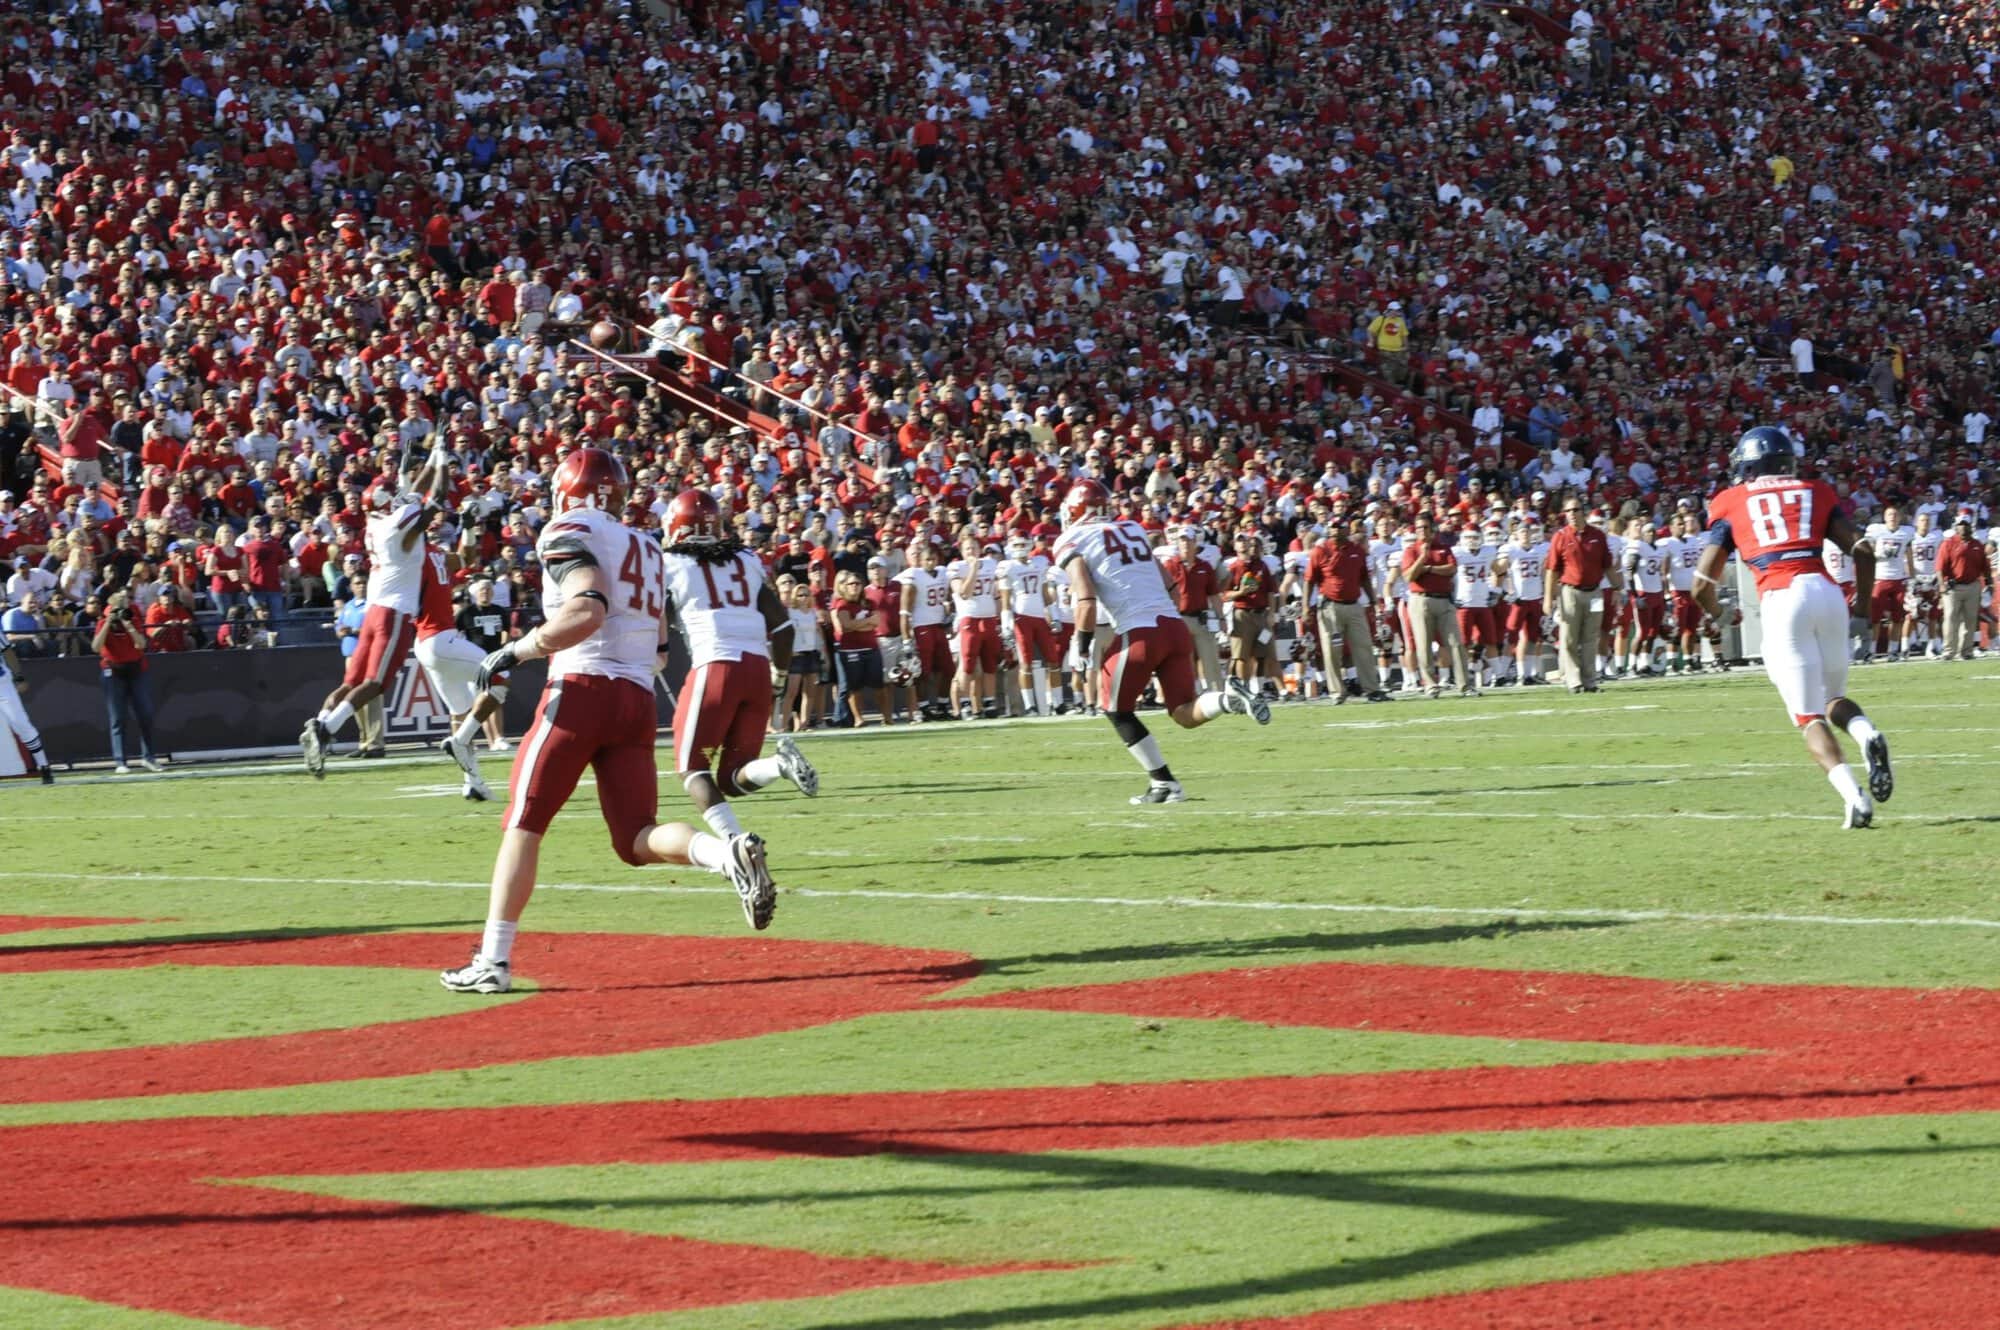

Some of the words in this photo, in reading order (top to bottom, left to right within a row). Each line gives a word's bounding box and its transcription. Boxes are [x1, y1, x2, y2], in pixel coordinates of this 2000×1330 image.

[1746, 488, 1813, 547] 87
[1103, 526, 1153, 565] 45
[618, 533, 665, 619] 43
[698, 556, 751, 609] 13
[1021, 574, 1039, 595] 17
[1463, 564, 1488, 583] 54
